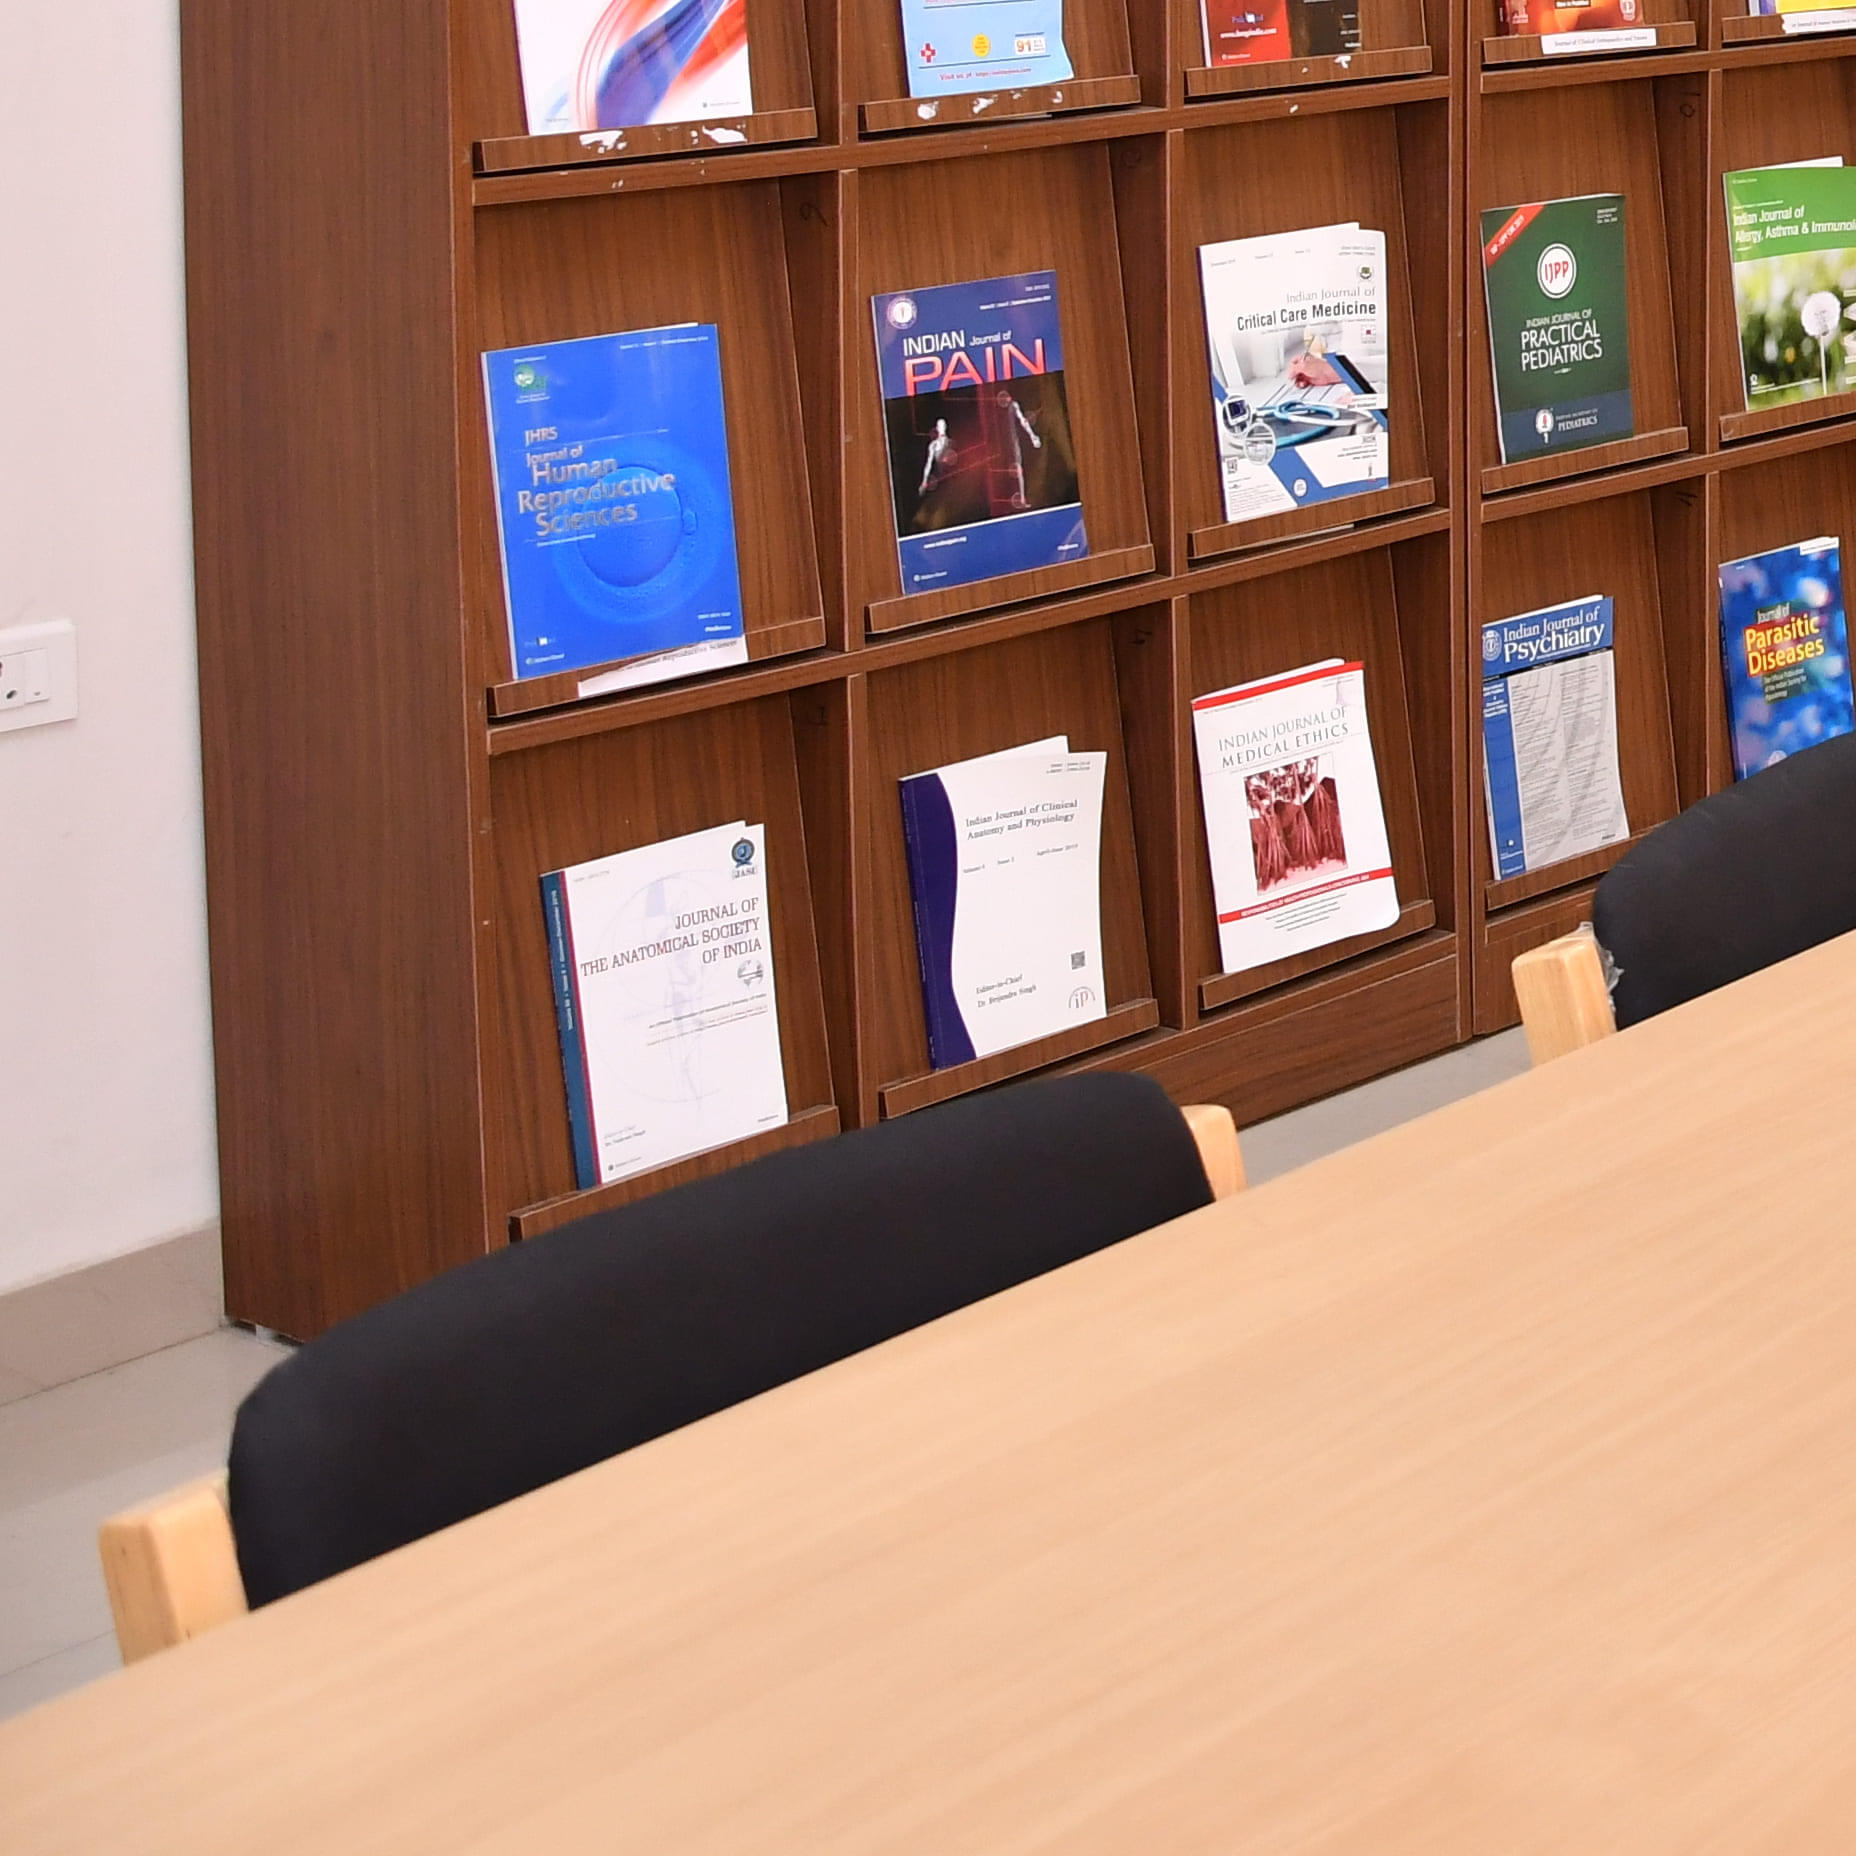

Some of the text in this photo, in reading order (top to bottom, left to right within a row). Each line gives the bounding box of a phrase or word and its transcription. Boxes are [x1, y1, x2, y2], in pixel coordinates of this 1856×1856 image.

[1016, 39, 1031, 52] 91
[1734, 205, 1804, 227] Indian Journal of
[1735, 230, 1764, 244] Allergy,
[1766, 224, 1799, 240] Asthma
[1802, 222, 1809, 234] &
[1545, 260, 1568, 283] IJPP
[1286, 286, 1375, 304] Indian Journal of
[1237, 300, 1376, 332] Critical Care Medicine
[1526, 308, 1592, 328] INDIAN JOURNAL OF
[904, 330, 1012, 356] INDIAN Journal of
[1521, 320, 1600, 350] PRACTICAL
[904, 338, 1047, 397] PAIN
[1521, 338, 1602, 372] PEDIATRICS
[526, 428, 558, 446] JHRS
[1558, 416, 1598, 432] PEDIATRICS
[527, 445, 584, 467] Journal of
[532, 458, 618, 486] Human
[518, 471, 676, 514] Reproductive
[537, 502, 638, 536] Sciences
[1504, 607, 1600, 643] Indian Journal of
[1745, 614, 1820, 652] Parasitic
[1504, 624, 1605, 663] Psychiatry
[1748, 638, 1825, 676] Diseases
[1218, 707, 1347, 752] INDIAN JOURNAL OF
[1222, 724, 1348, 769] MEDICAL ETHICS
[966, 799, 1078, 828] Indian Journal of Clinical
[967, 812, 1075, 841] Anatomy and Physiology
[675, 898, 759, 930] JOURNAL OF
[581, 917, 760, 977] THE ANATOMICAL SOCIETY
[702, 938, 762, 964] OF INDIA
[976, 974, 1023, 994] Editor-in-Chief
